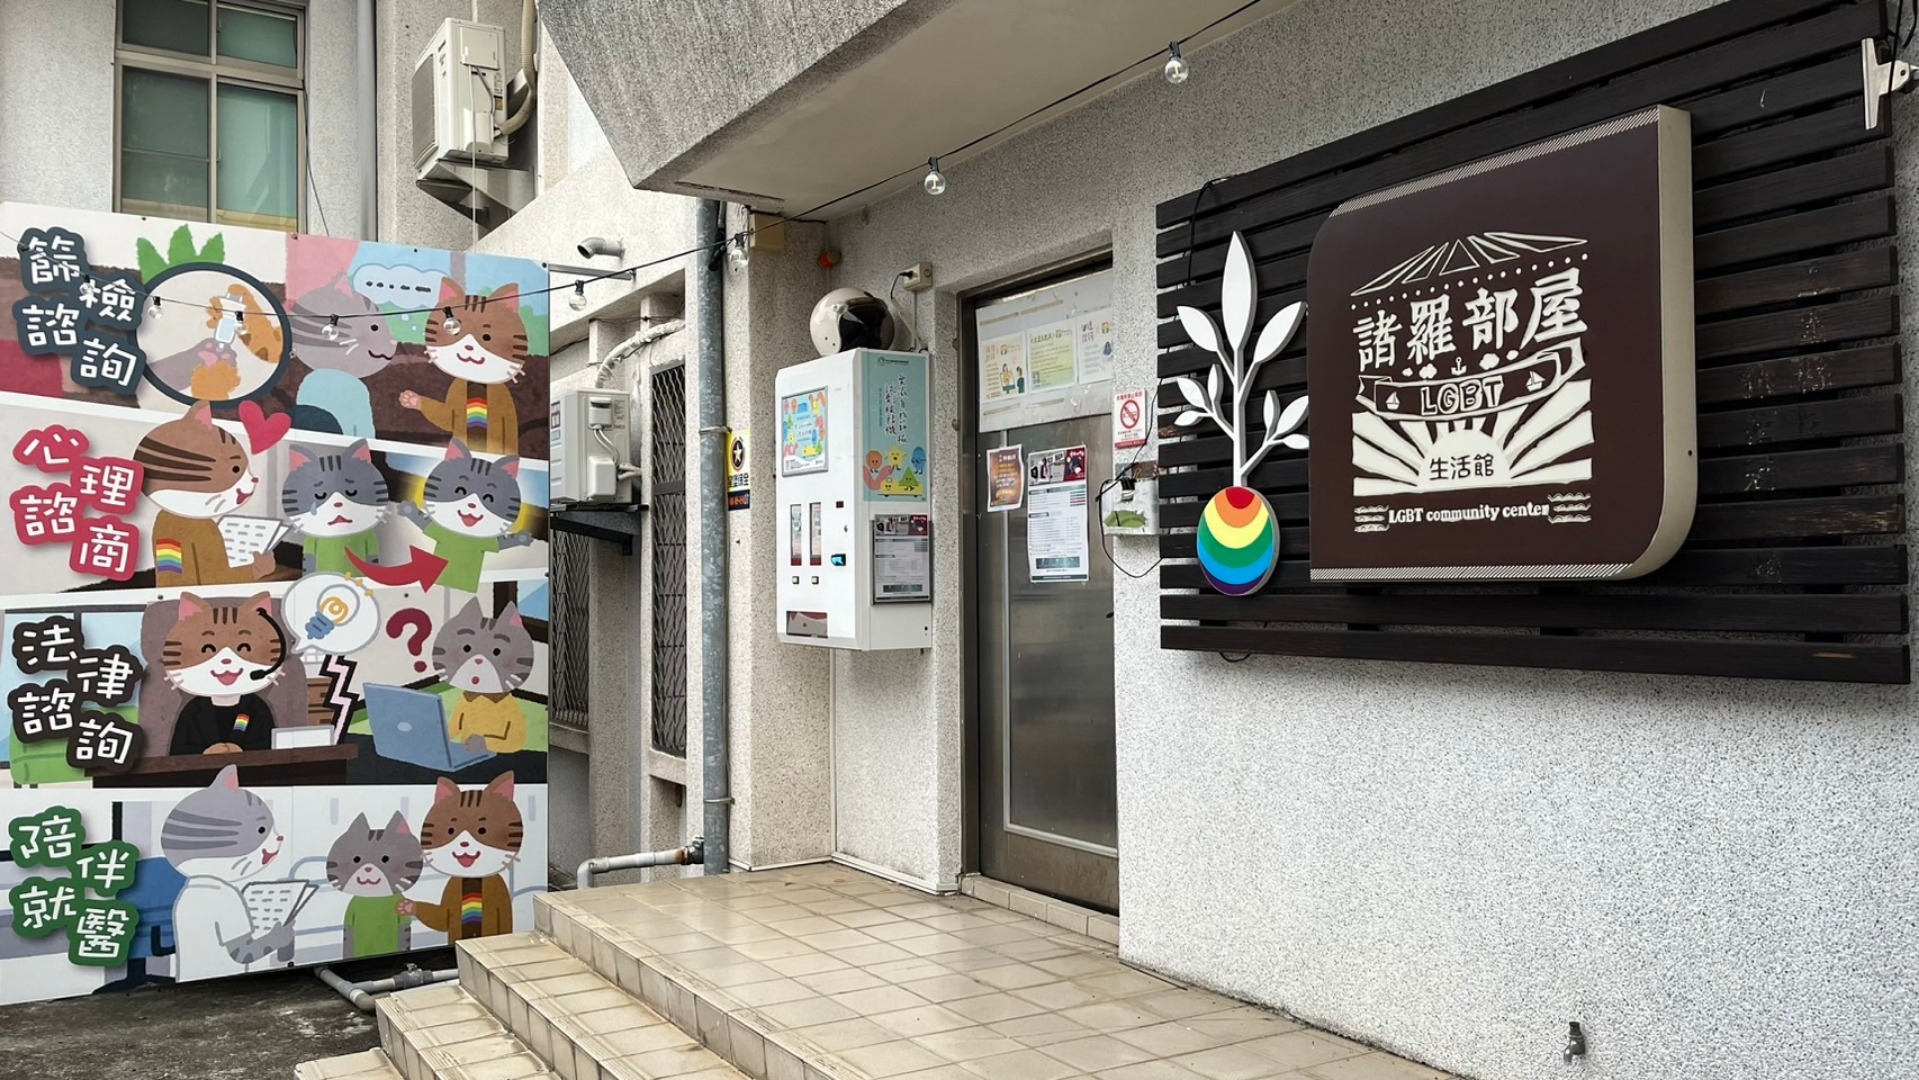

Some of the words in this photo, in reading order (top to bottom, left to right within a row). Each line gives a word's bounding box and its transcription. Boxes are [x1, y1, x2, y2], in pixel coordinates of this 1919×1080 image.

[21, 302, 137, 387] 諮詢
[1352, 267, 1588, 372] 諸羅部屋
[1419, 375, 1504, 417] LGBT
[23, 433, 135, 506] 心理
[1429, 453, 1495, 480] 生活館
[19, 491, 130, 573] 諮商
[1388, 508, 1424, 524] LGBT
[1425, 504, 1500, 522] community
[1502, 501, 1550, 518] center
[21, 624, 134, 700] 法律
[17, 687, 134, 765] 諮詢
[19, 815, 130, 889] 陪伴
[18, 885, 130, 958] 就醫
